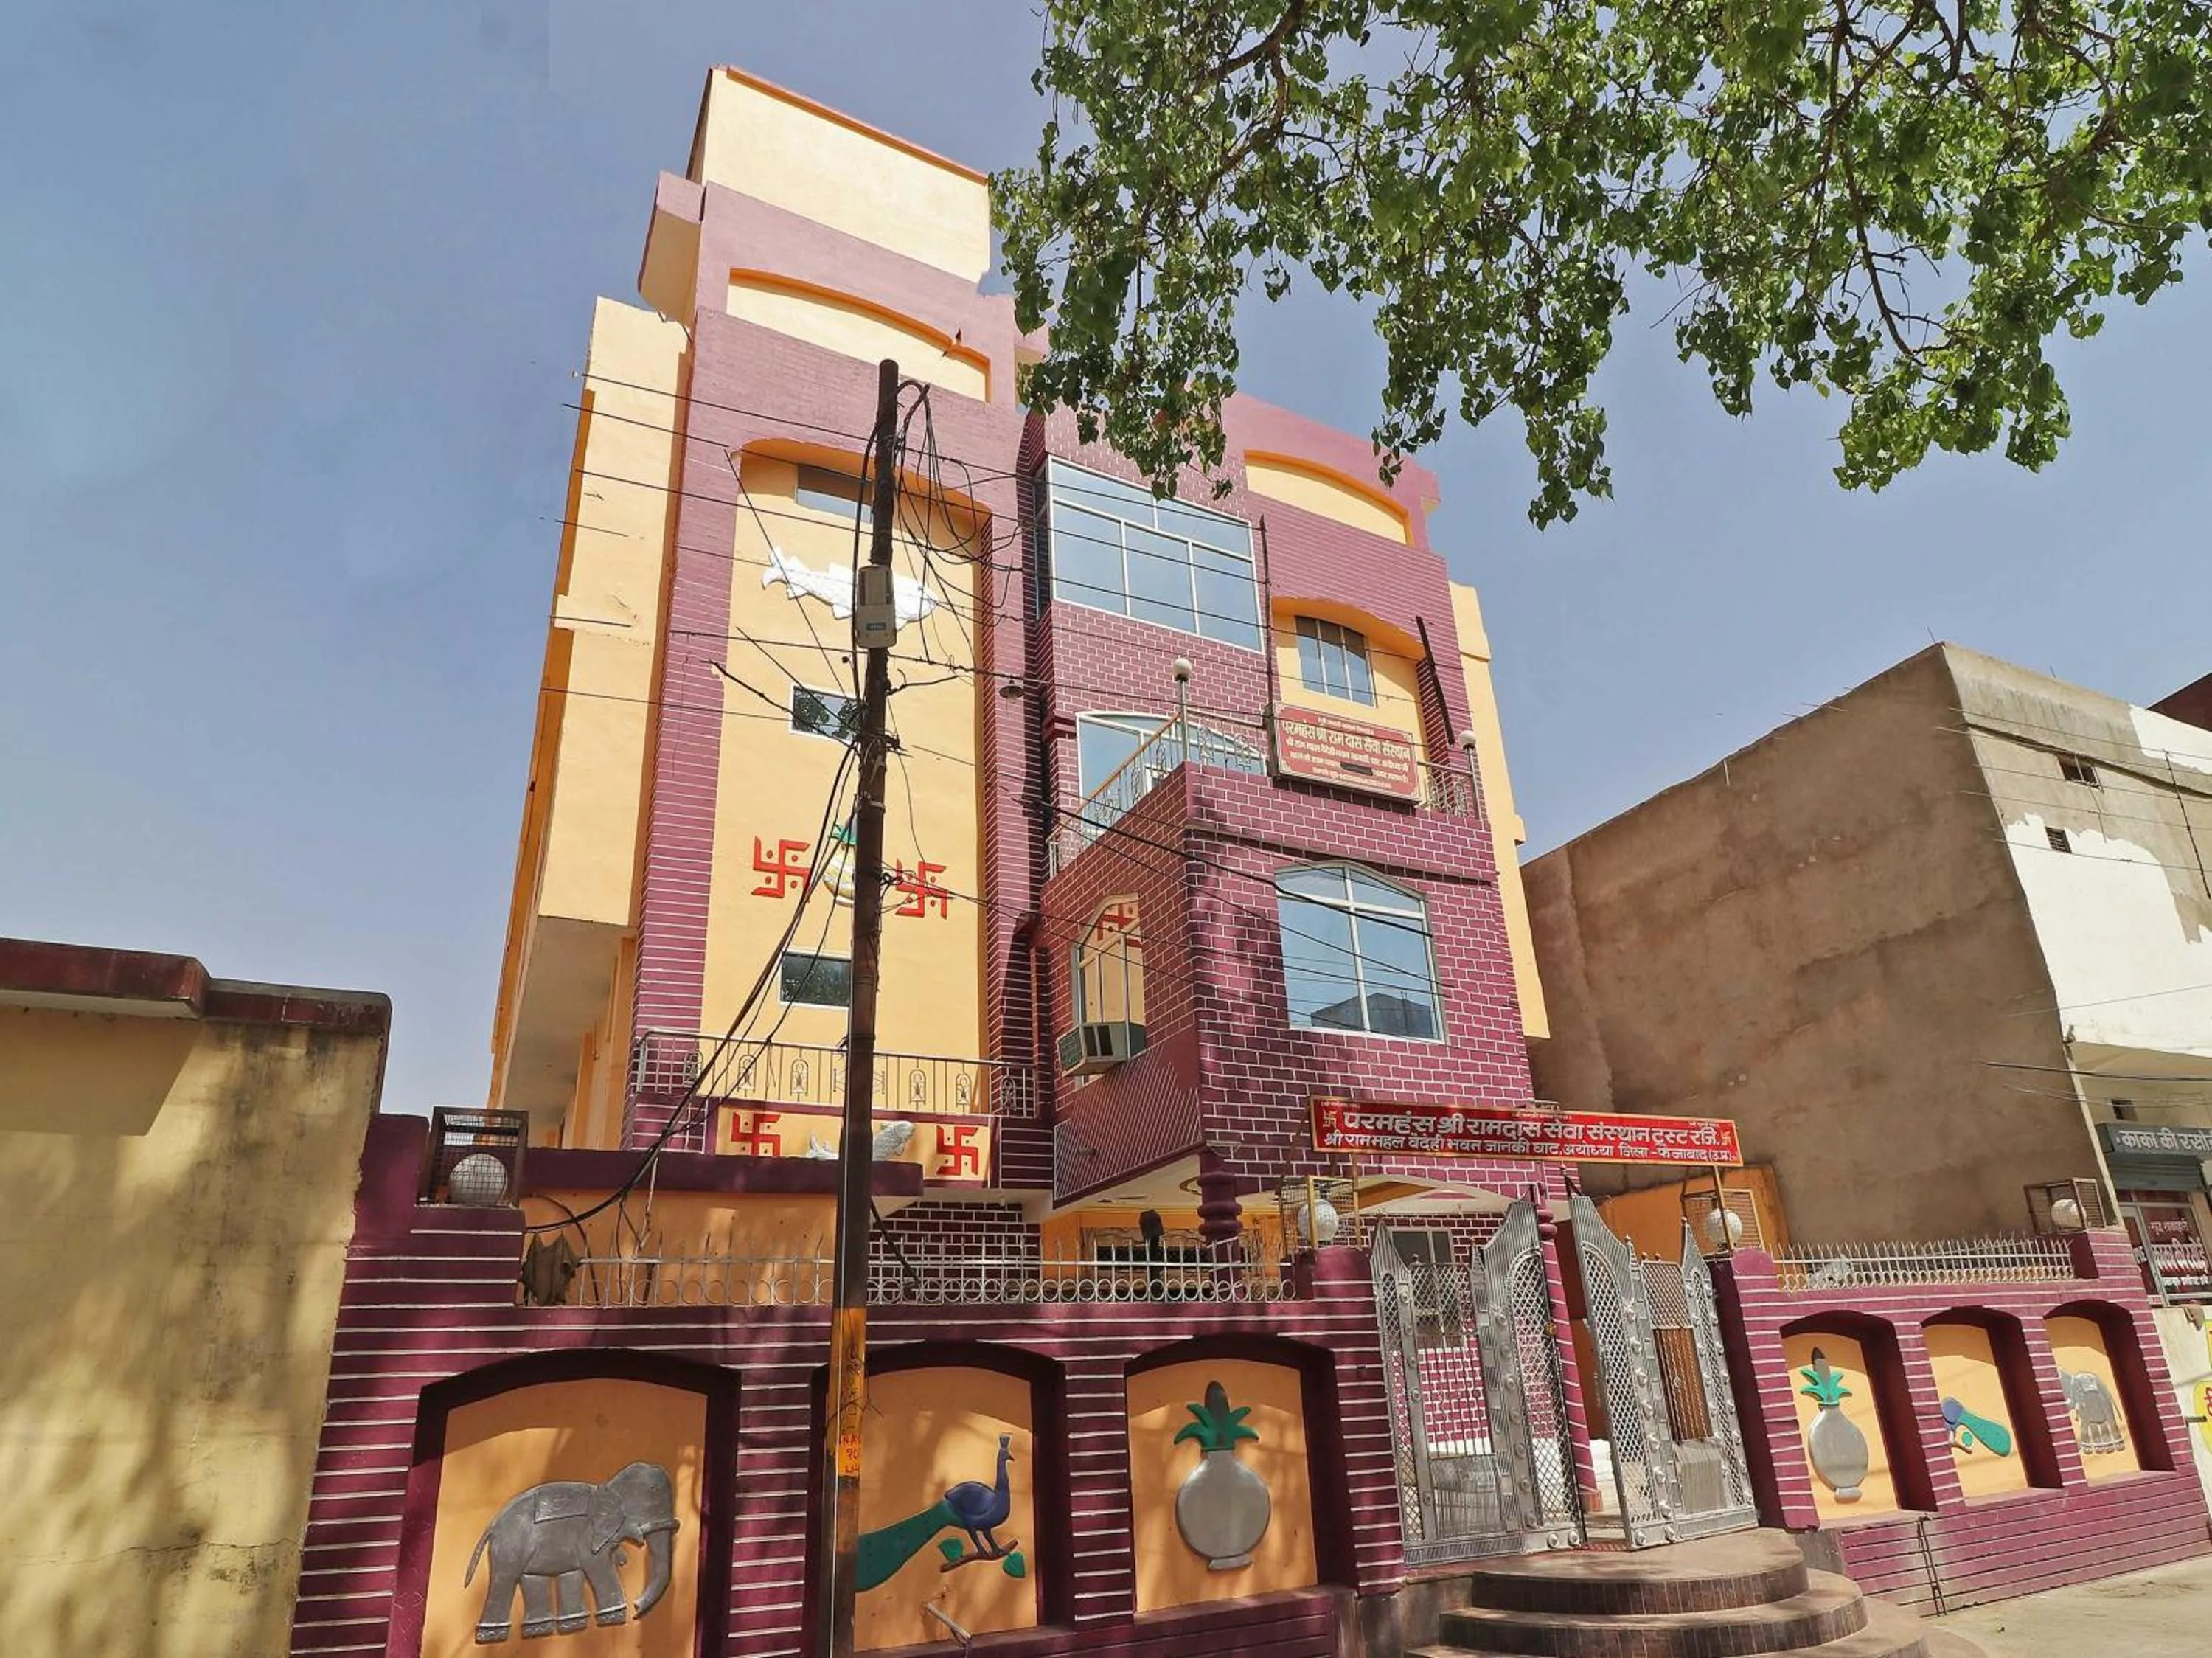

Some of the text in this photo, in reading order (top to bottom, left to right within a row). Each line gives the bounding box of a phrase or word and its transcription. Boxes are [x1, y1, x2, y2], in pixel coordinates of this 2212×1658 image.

[1343, 1111, 1437, 1134] परमहंस
[1438, 1113, 1464, 1134] श्री
[1467, 1119, 1542, 1140] रामदास
[1544, 1120, 1585, 1140] सेवा
[1587, 1122, 1651, 1142] संस्थान
[1652, 1129, 1688, 1148] ट्रस्ट
[2119, 1131, 2159, 1148] काका
[2157, 1127, 2179, 1149] की
[1324, 1130, 1342, 1148] श्री
[1484, 1138, 1530, 1154] जानकी
[1563, 1142, 1613, 1157] अयोध्या
[1619, 1143, 1649, 1159] जिला
